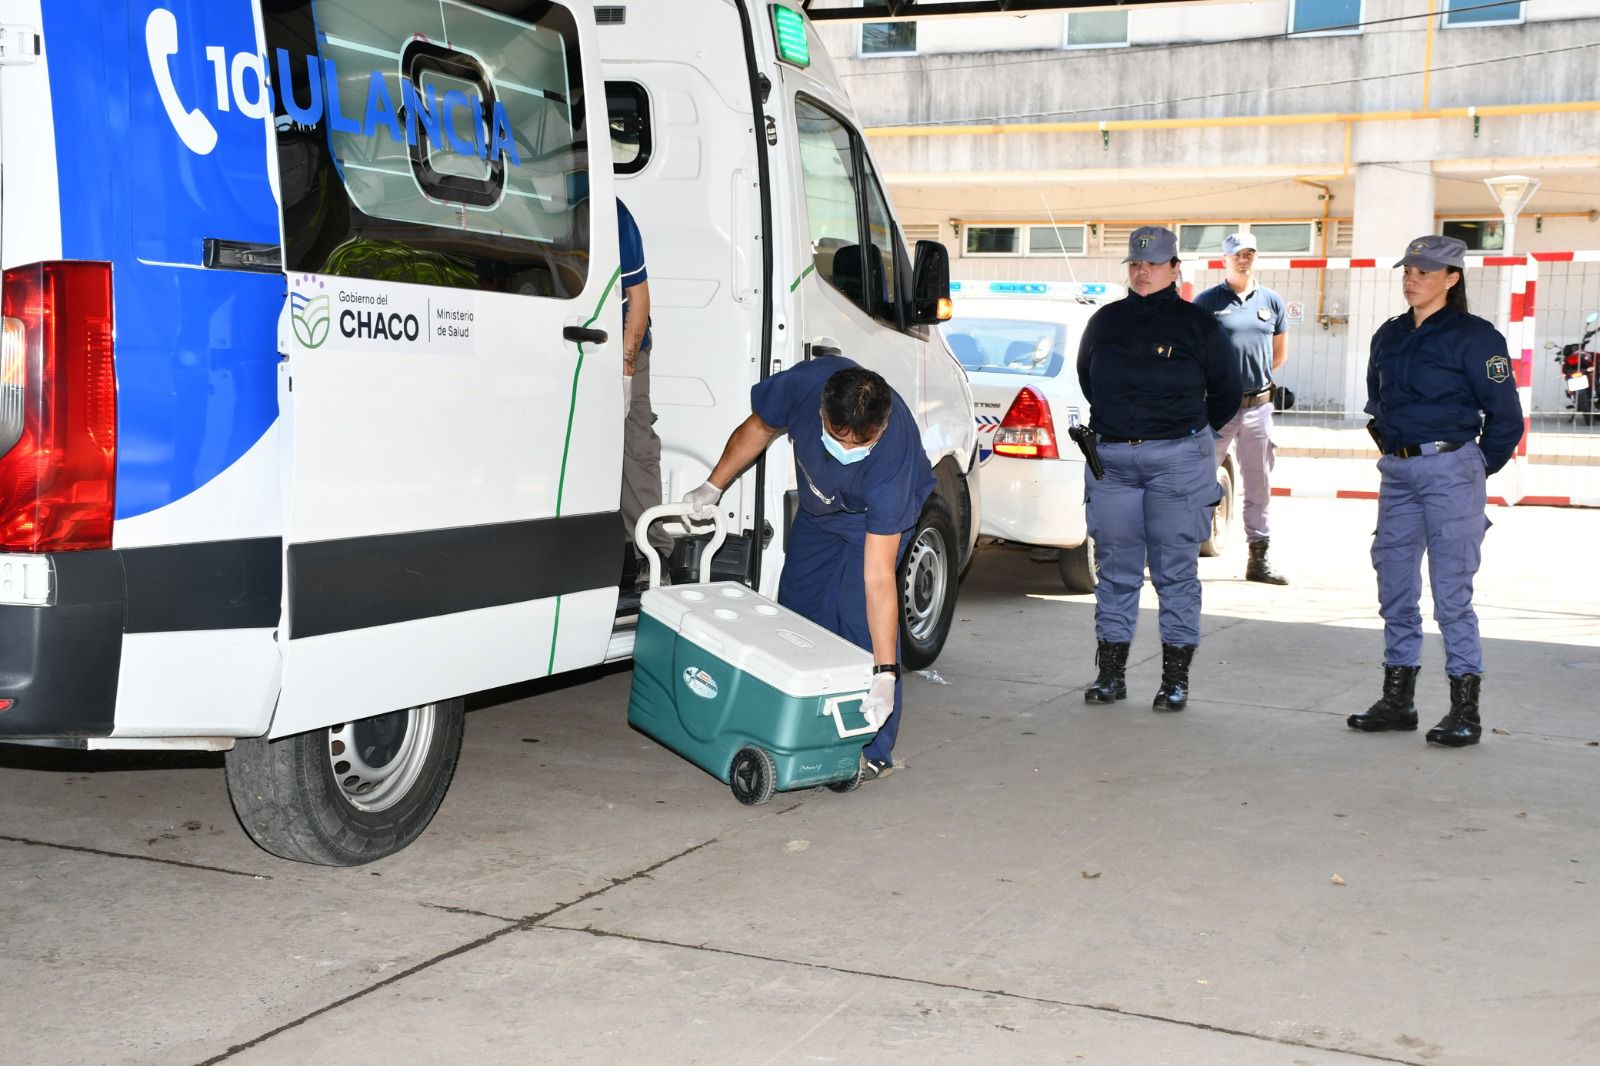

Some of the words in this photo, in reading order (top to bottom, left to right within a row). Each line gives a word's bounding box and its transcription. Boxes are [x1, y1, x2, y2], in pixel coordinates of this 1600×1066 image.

[263, 48, 521, 167] ULANCIA
[339, 291, 375, 304] Gobierno
[376, 294, 388, 305] del
[436, 308, 474, 322] Ministerio
[339, 309, 419, 341] CHACO
[437, 325, 447, 336] de
[448, 326, 469, 337] Salud
